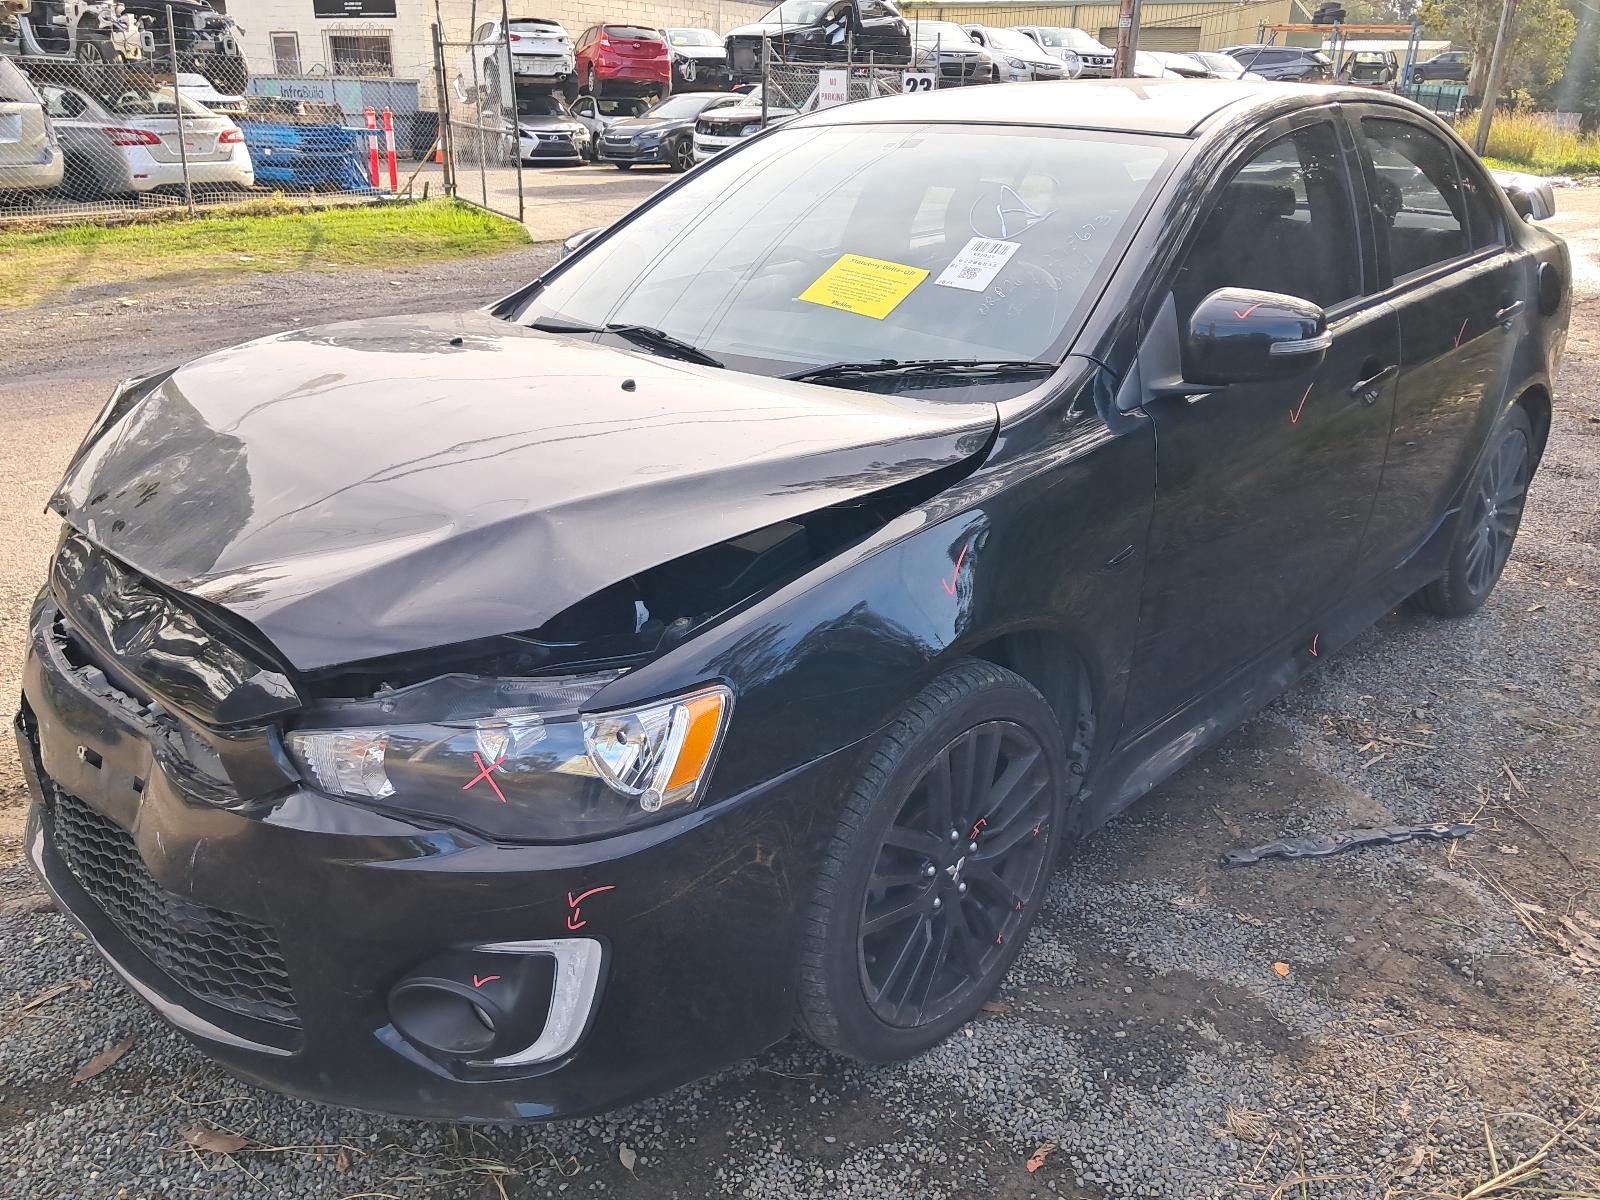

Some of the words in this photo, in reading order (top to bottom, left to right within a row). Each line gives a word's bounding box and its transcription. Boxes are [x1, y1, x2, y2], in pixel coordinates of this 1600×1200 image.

[280, 85, 325, 99] InfraBuild
[821, 92, 845, 102] PARKING
[849, 258, 883, 270] Statutory
